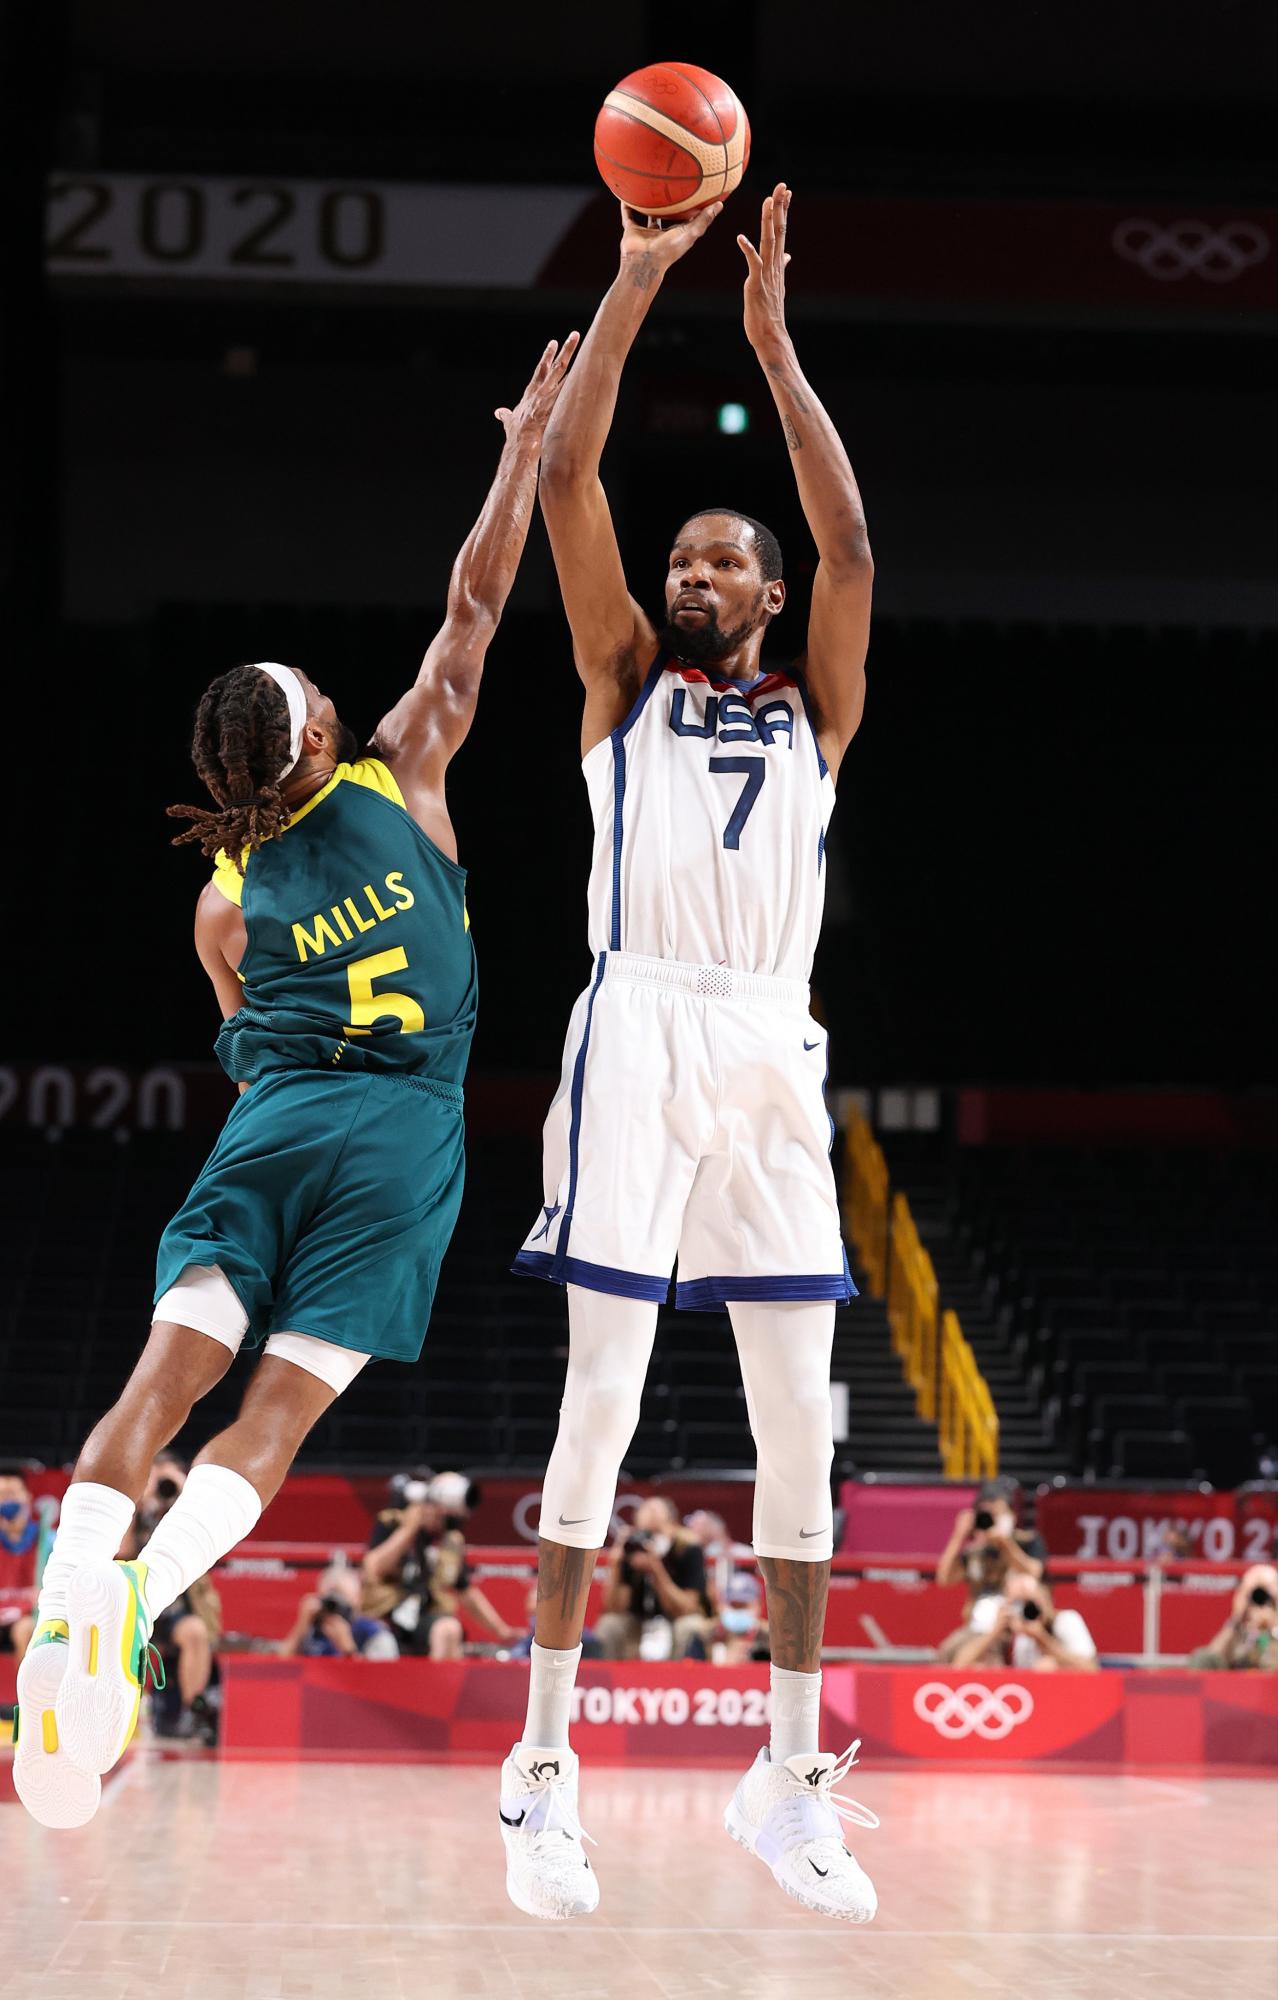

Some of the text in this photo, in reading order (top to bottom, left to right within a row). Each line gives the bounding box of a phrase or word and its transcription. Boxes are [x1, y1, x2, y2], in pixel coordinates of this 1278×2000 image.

[49, 178, 387, 270] 2020
[668, 688, 794, 750] USA
[708, 756, 766, 851] 7
[291, 871, 415, 963] MILLS
[343, 945, 425, 1037] 5
[692, 1688, 771, 1726] 202
